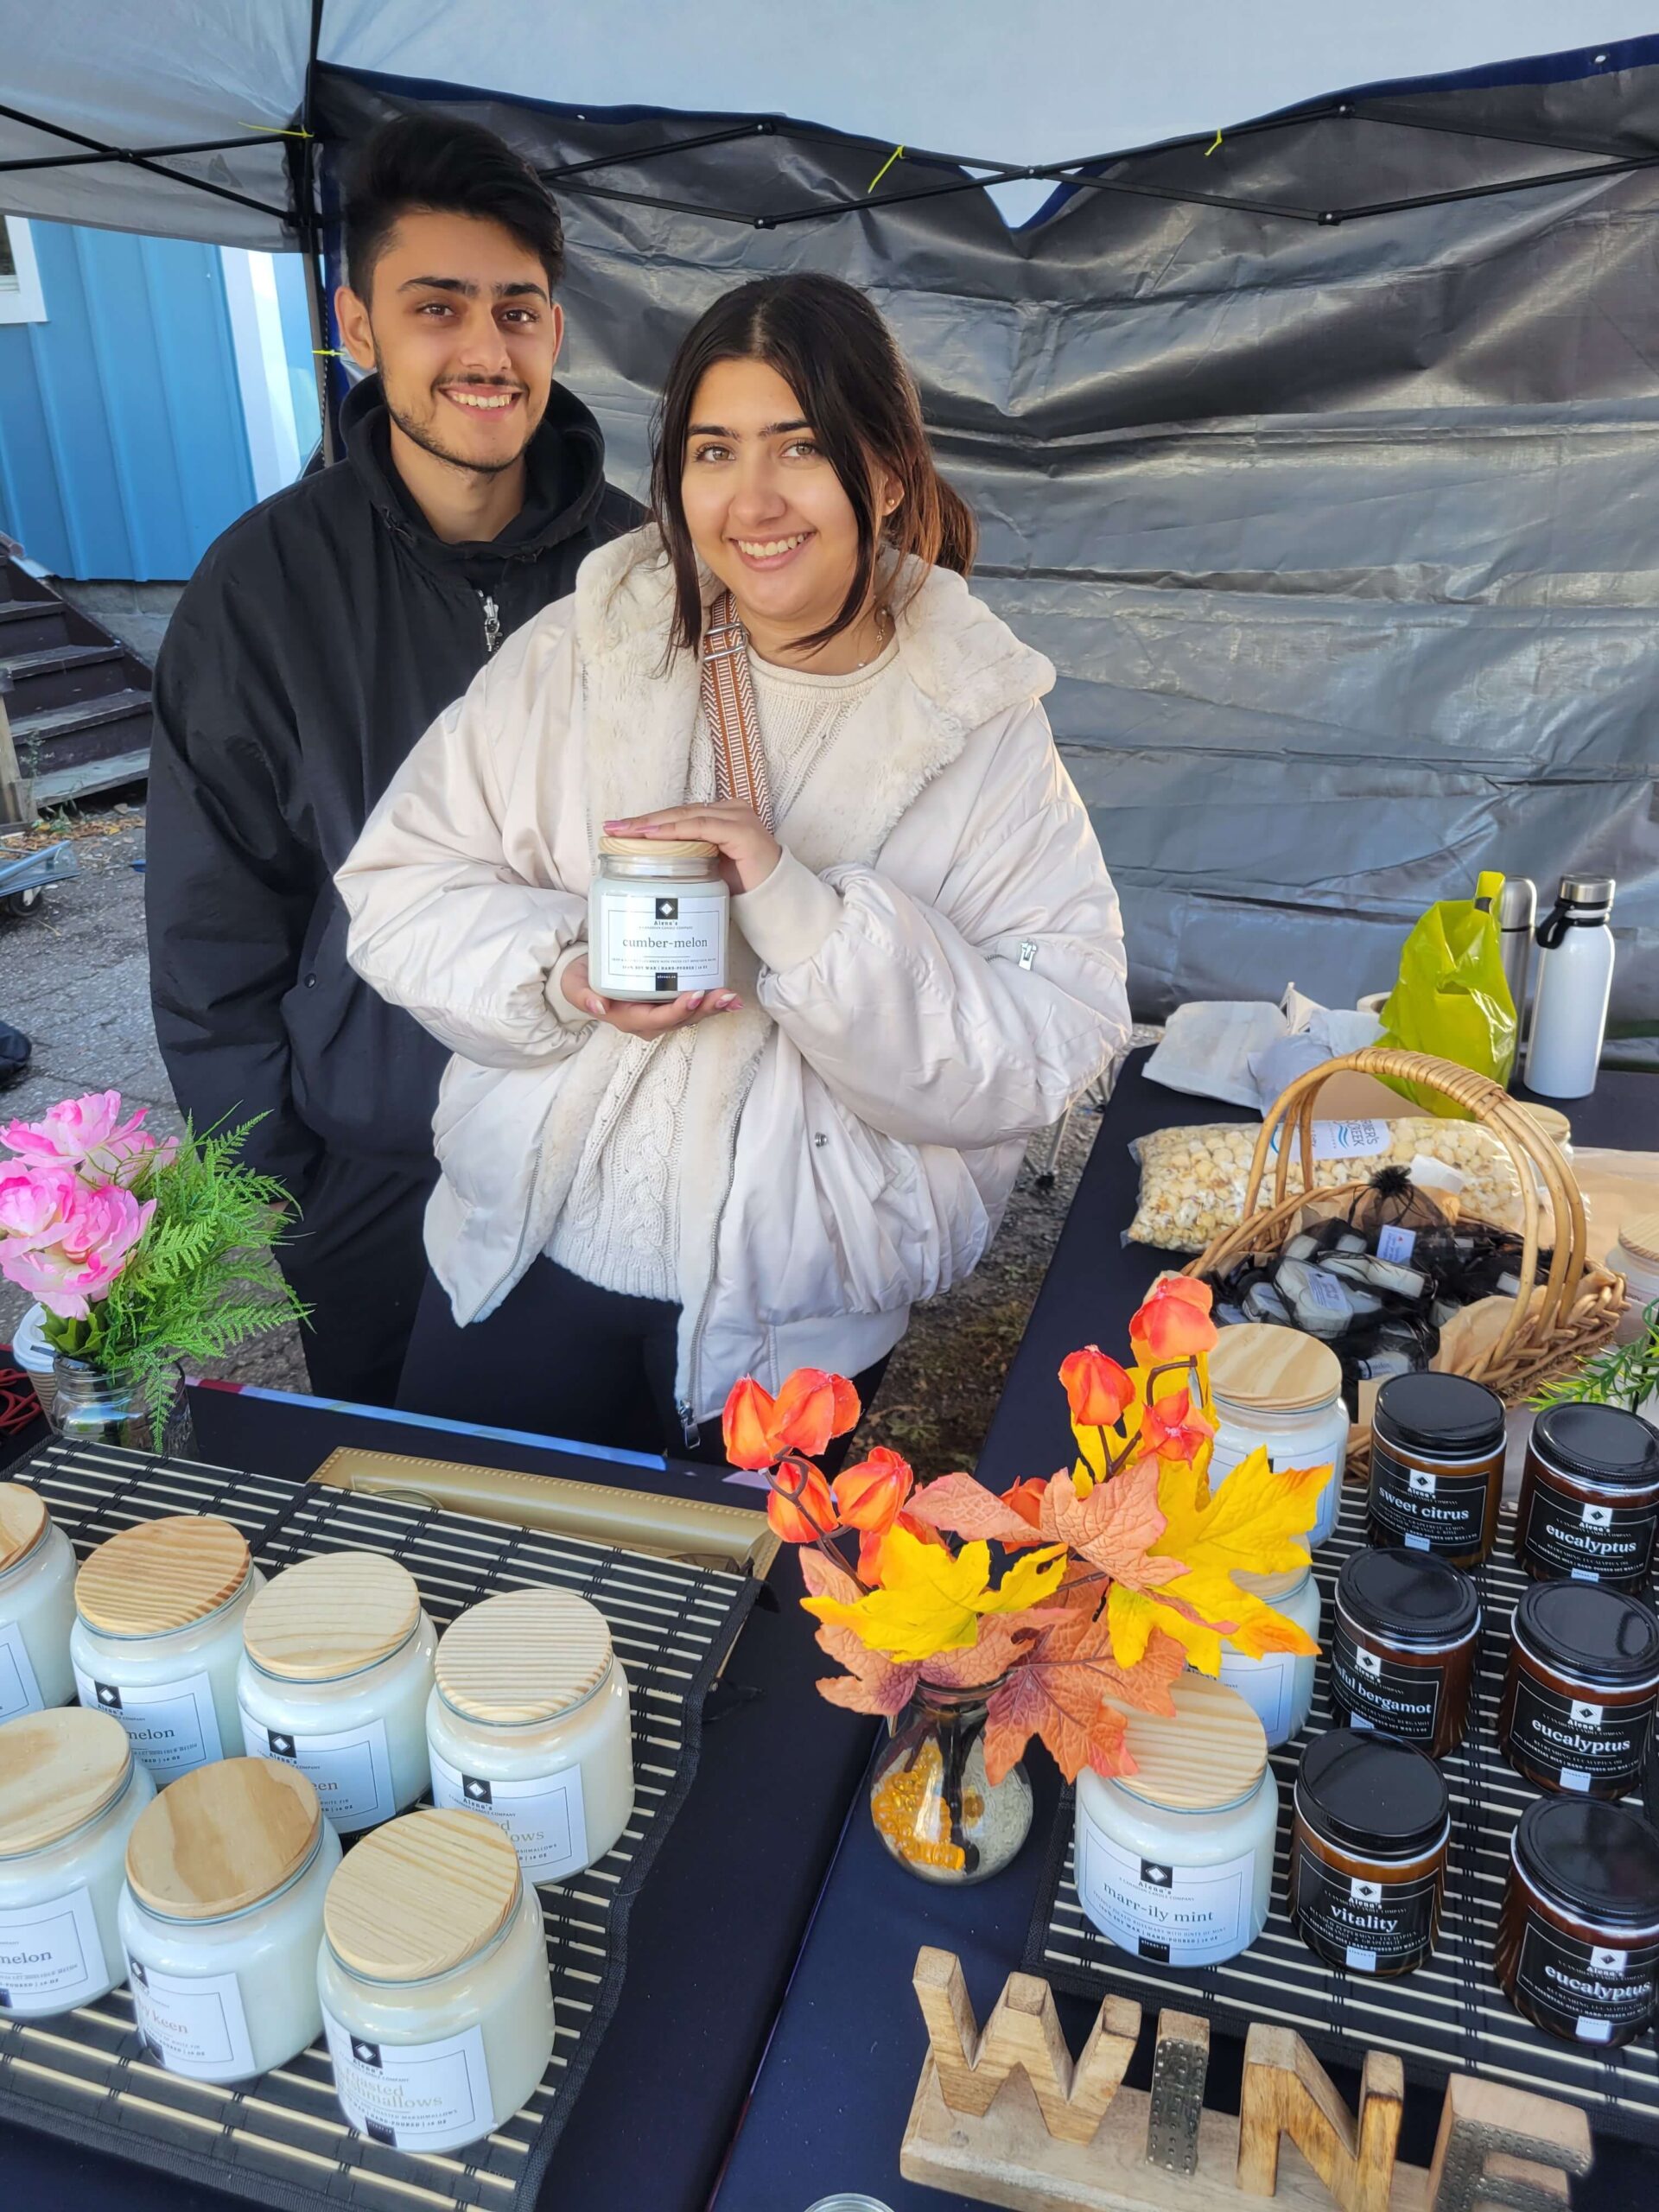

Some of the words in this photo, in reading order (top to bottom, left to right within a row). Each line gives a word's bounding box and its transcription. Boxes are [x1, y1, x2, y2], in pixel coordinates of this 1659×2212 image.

[622, 937, 708, 948] cumber-melon
[1379, 1487, 1417, 1514] sweet
[1421, 1506, 1469, 1520] citrus
[1546, 1524, 1637, 1555] eucalyptus
[1358, 1682, 1432, 1713] bergamot
[1567, 1719, 1601, 1732] Alena's
[1532, 1719, 1630, 1755] eucalyptus
[312, 1781, 339, 1791] een
[462, 1797, 493, 1811] Alena's
[1138, 1881, 1172, 1895] Alena's
[1103, 1882, 1169, 1923] marr-ily
[1174, 1911, 1214, 1923] mint
[1348, 1897, 1382, 1910] Alena's
[1331, 1904, 1399, 1933] vitality
[1586, 1967, 1624, 1977] Alena's
[1545, 1966, 1651, 2001] eucalyptus
